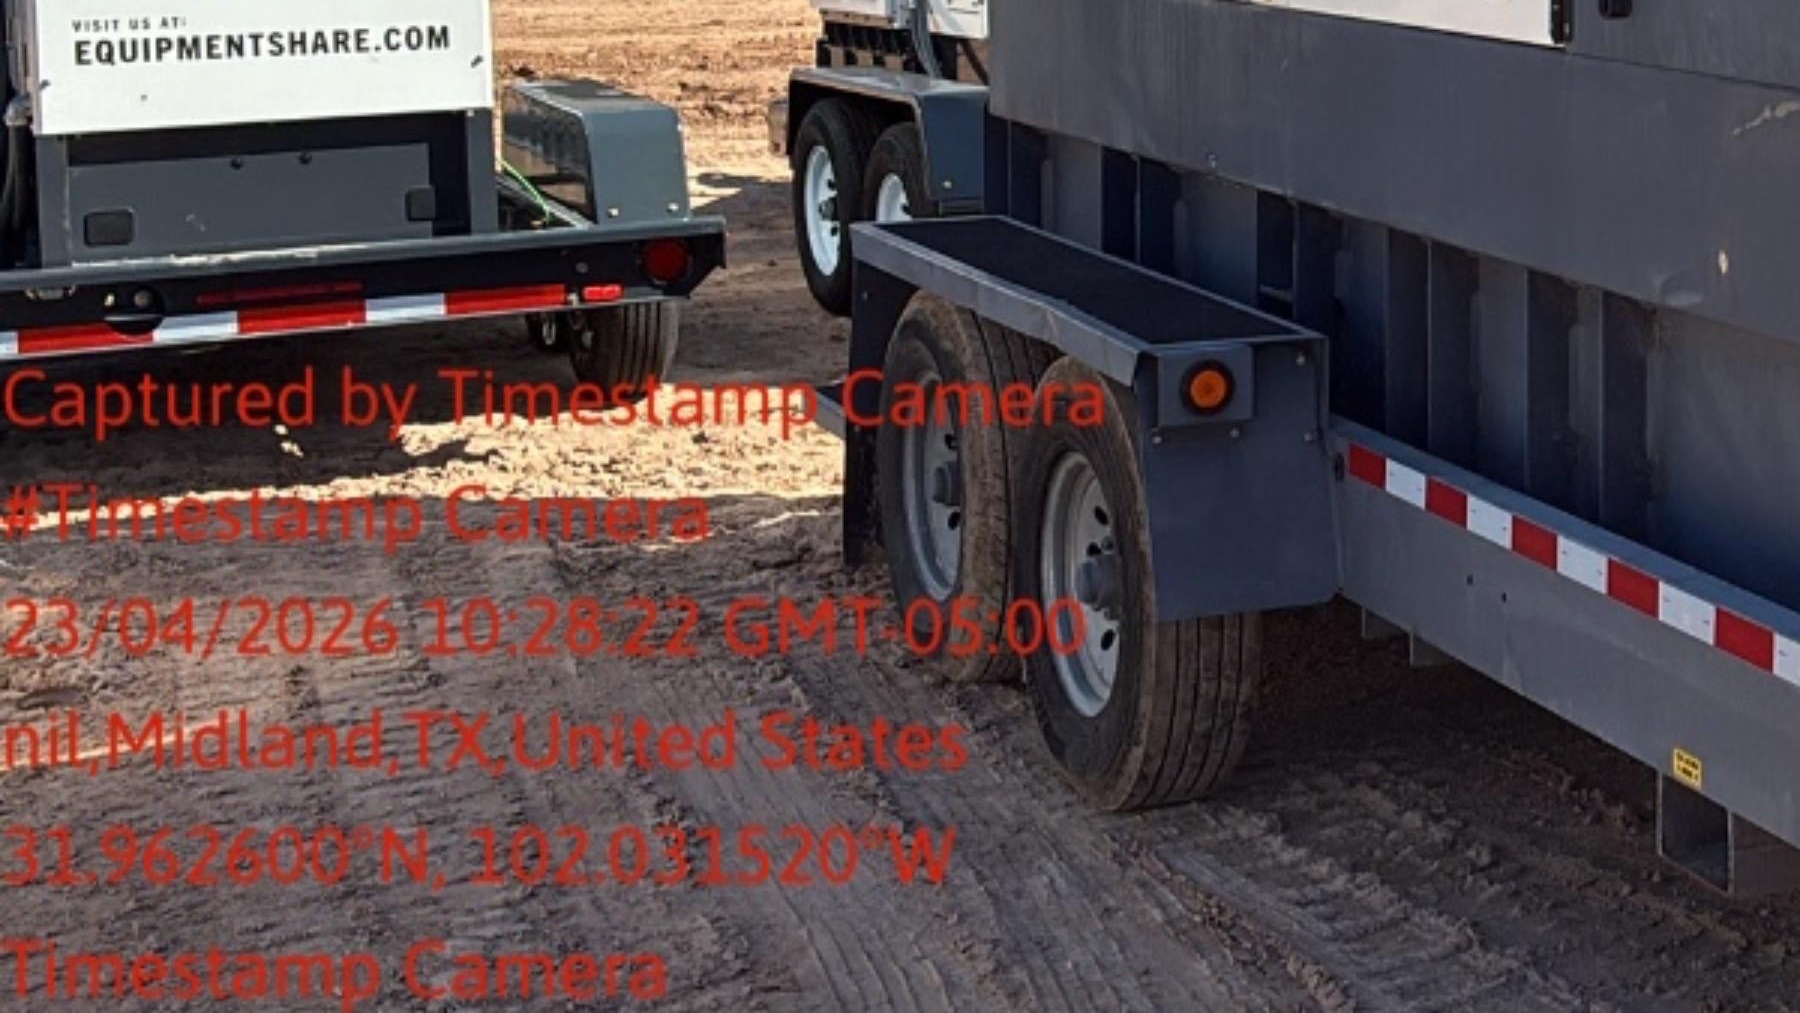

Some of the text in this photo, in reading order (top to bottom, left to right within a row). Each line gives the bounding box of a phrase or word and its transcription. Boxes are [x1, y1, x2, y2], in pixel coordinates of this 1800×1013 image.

[72, 20, 119, 32] VISIT
[129, 18, 151, 30] US
[74, 25, 450, 65] EQUIPMENTSHARE.COM
